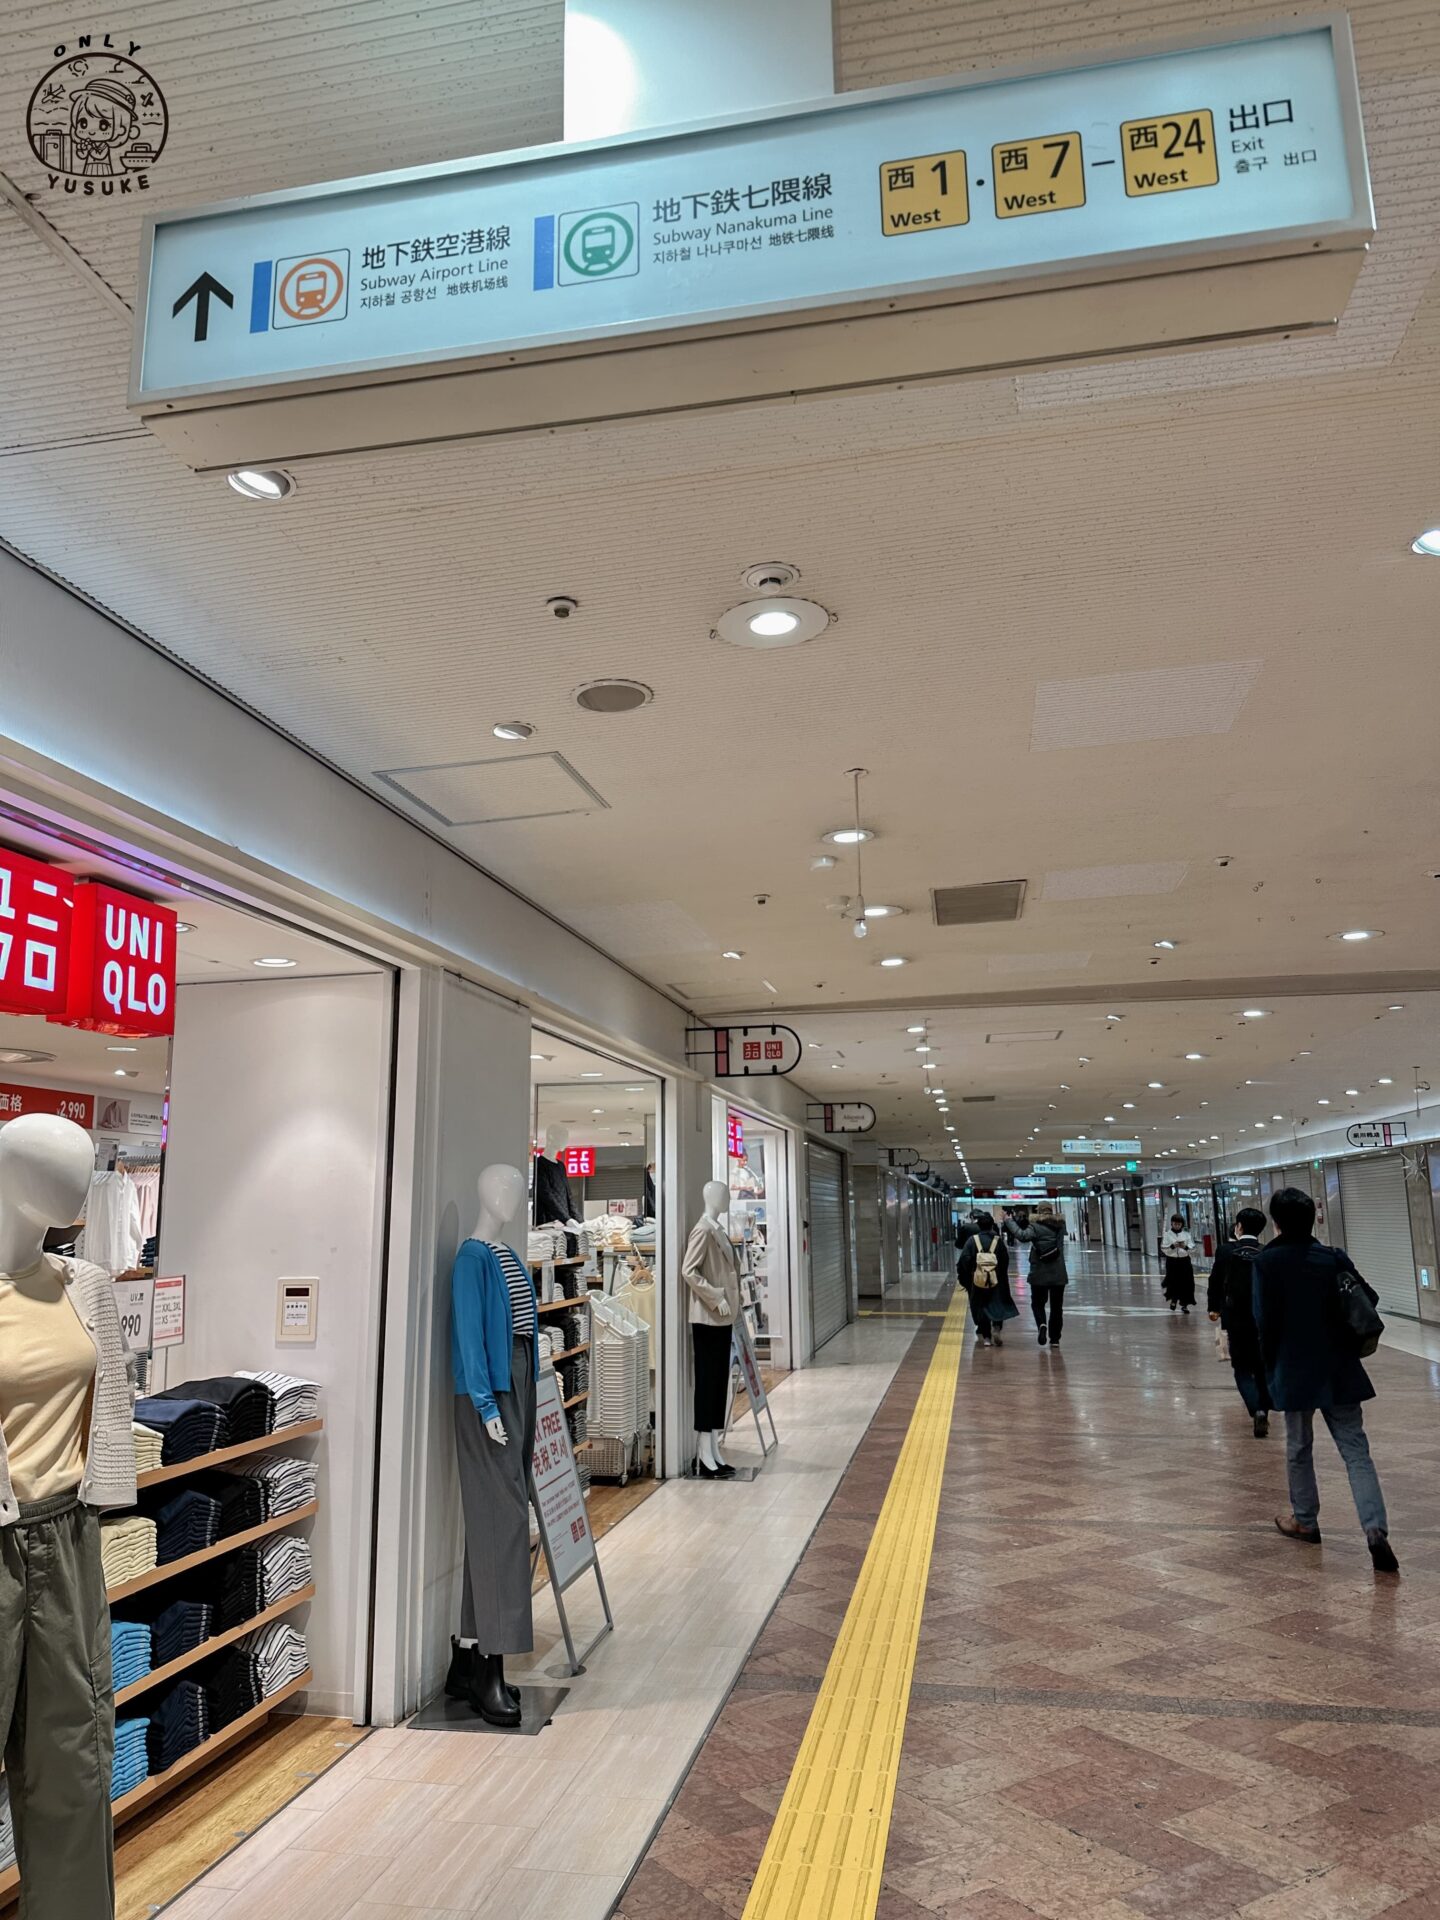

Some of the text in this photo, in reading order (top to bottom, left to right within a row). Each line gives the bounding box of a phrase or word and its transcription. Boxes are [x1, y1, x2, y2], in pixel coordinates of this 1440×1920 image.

[1229, 99, 1294, 132] 出口
[1128, 118, 1206, 159] 西 24
[1232, 136, 1264, 153] Exit
[1000, 140, 1070, 179] 西 7
[1234, 149, 1317, 174] 출구 出口
[887, 160, 948, 196] 西 1
[1134, 168, 1188, 189] West
[652, 173, 832, 223] 地下鉄七隈線
[1004, 190, 1056, 210] West
[653, 207, 833, 246] Subway Nanakuma Line
[891, 208, 941, 228] West
[361, 225, 511, 270] 地下鉄空港線
[653, 225, 835, 265] 지하철 나나쿠마선 地铁七隈线
[360, 259, 508, 291] Subway Airport Line
[360, 276, 508, 310] 지하철 공항선 地铁机场线
[105, 904, 163, 963] UNI
[103, 960, 166, 1015] QLO
[541, 1410, 562, 1438] FREE
